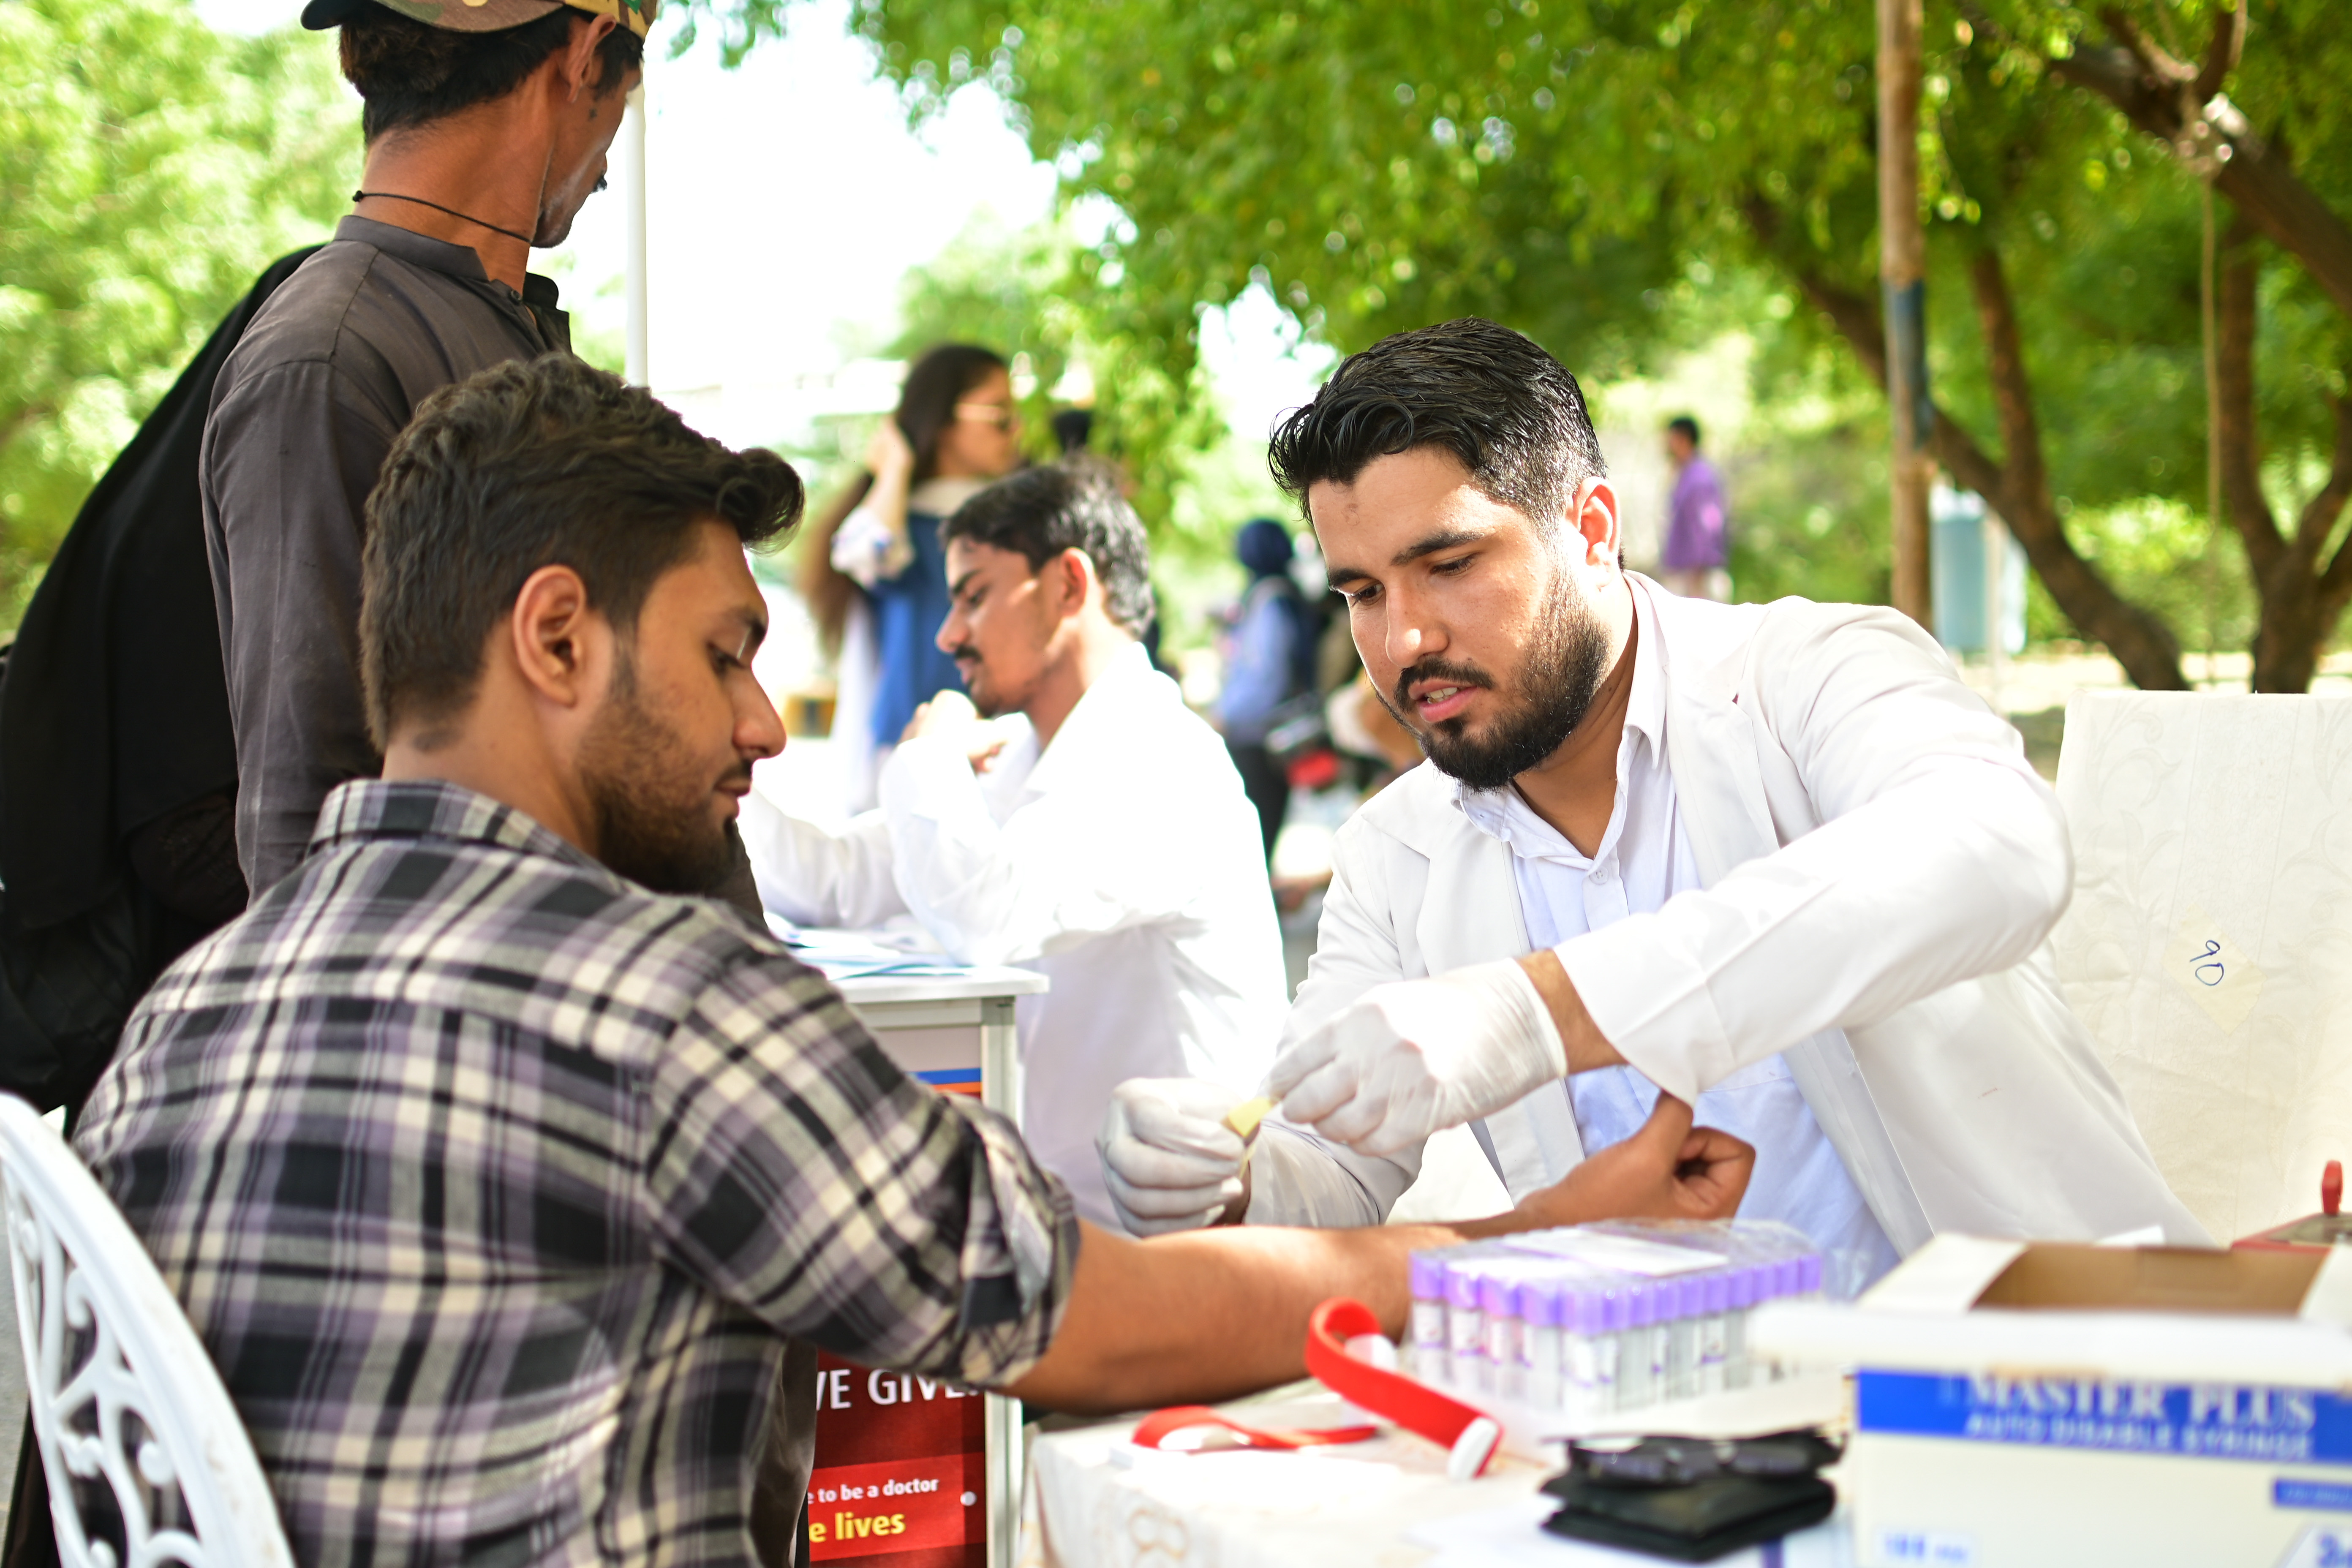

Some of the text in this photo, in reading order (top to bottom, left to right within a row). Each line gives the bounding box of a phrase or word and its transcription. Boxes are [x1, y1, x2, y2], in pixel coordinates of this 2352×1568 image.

[2191, 1383, 2316, 1433] PLUS
[817, 1488, 838, 1503] to
[840, 1484, 864, 1501] be
[866, 1485, 879, 1498] a
[882, 1478, 939, 1496] doctor
[834, 1511, 906, 1541] lives
